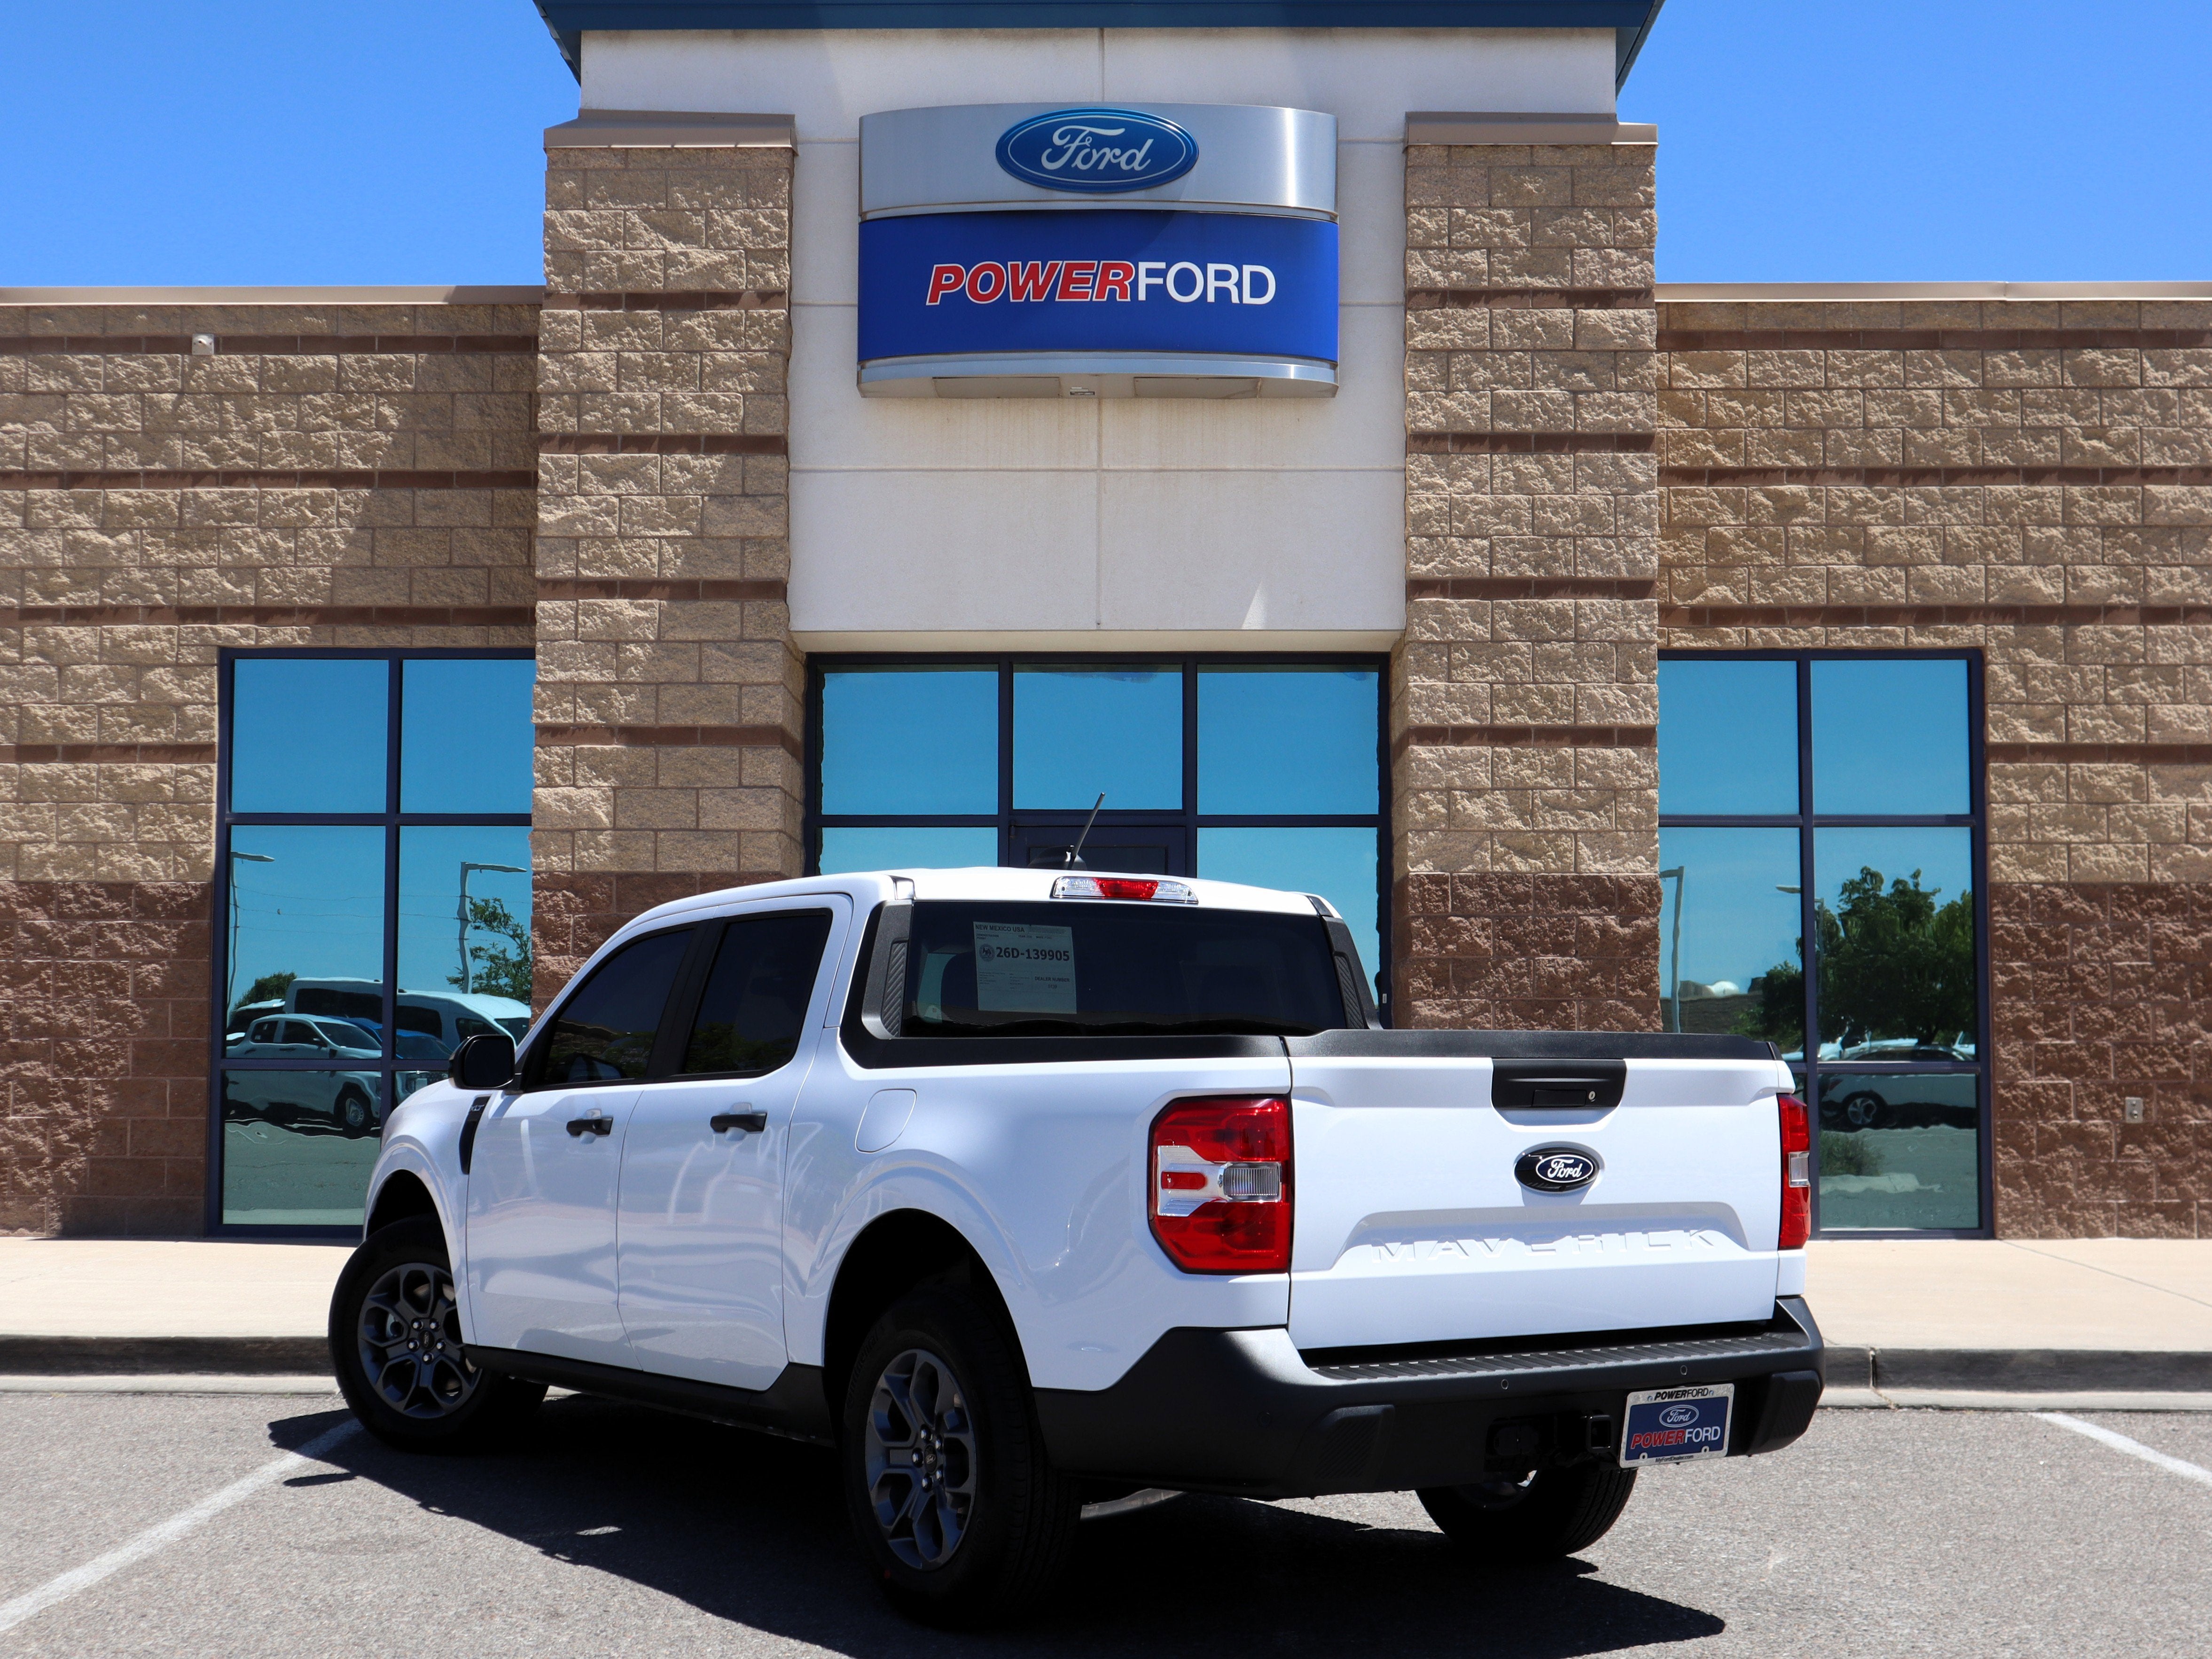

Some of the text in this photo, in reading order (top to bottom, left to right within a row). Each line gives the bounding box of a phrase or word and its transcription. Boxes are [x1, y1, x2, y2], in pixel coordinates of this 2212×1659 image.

[1041, 125, 1154, 172] Ford
[926, 260, 1276, 305] POWERFORD
[996, 947, 1070, 962] 26D-139905
[1547, 1158, 1583, 1178] Ford
[1371, 1228, 1714, 1263] MAVERICK
[1654, 1388, 1709, 1401] POWERFORD
[1667, 1409, 1691, 1423] Ford
[1630, 1426, 1720, 1449] POWERFORD
